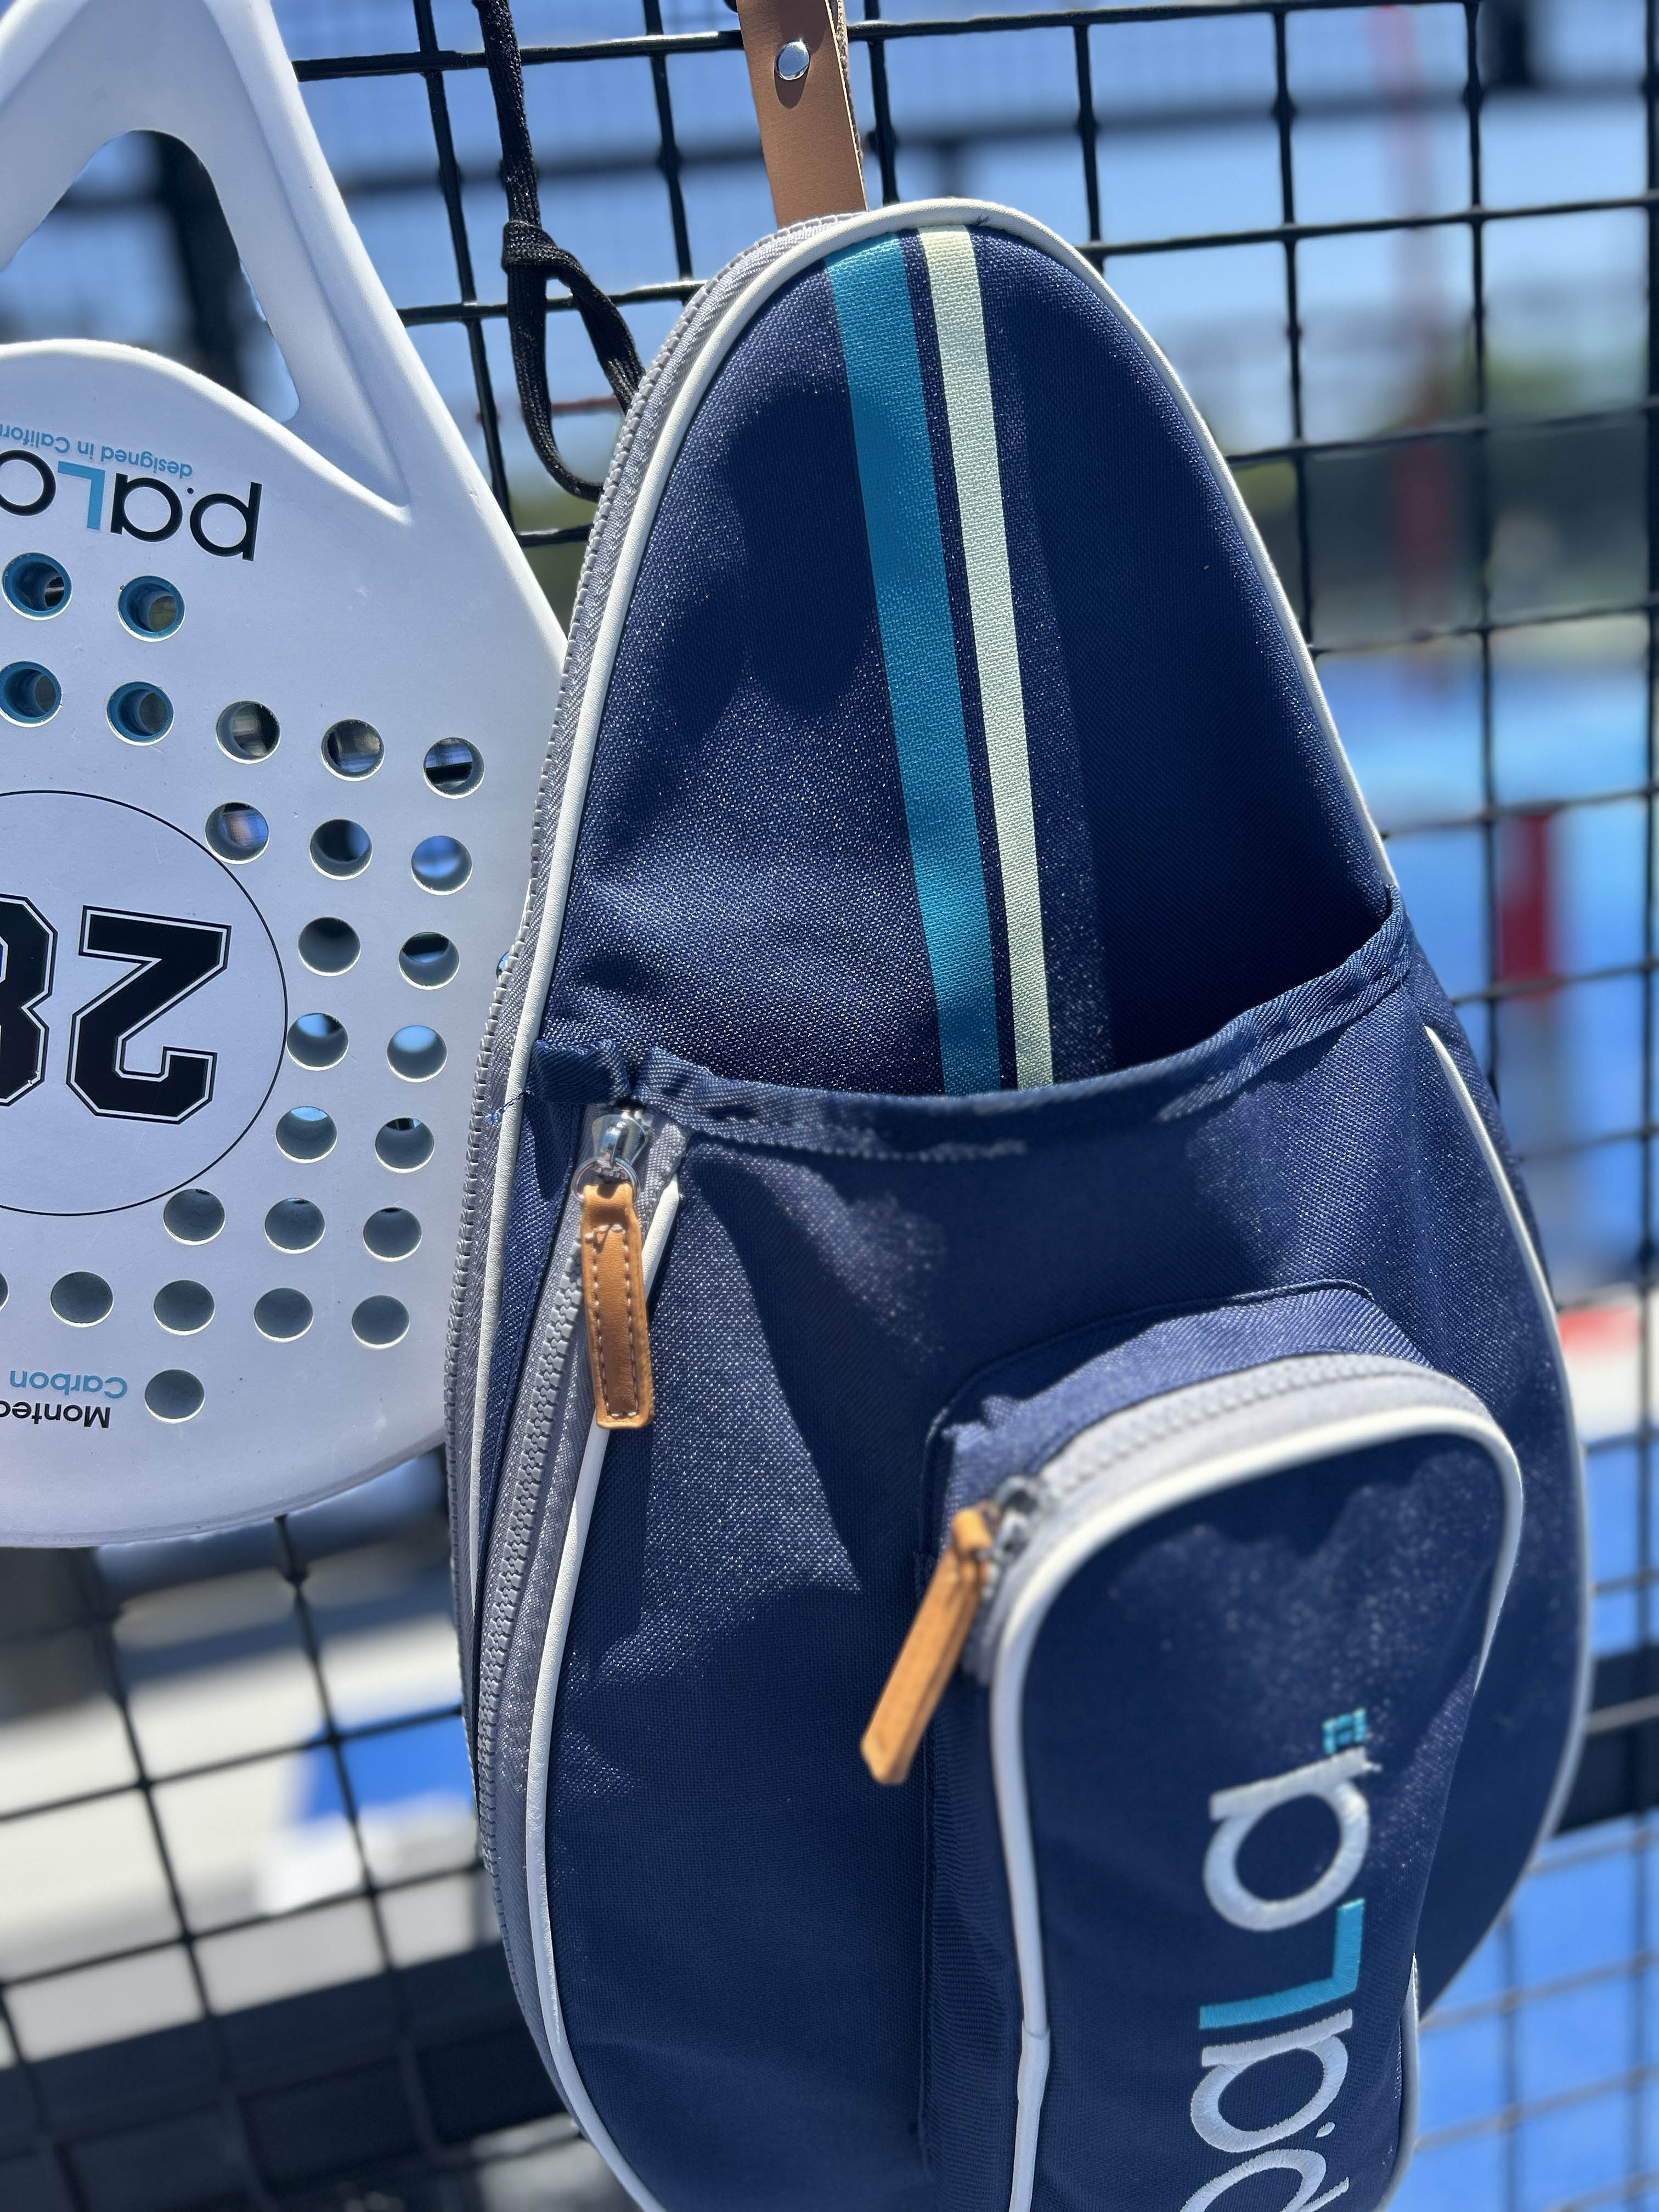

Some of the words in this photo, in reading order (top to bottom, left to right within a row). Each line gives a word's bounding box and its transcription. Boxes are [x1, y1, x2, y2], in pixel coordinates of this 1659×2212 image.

[77, 440, 94, 460] in
[100, 445, 193, 479] designed
[10, 1370, 128, 1398] Carbon
